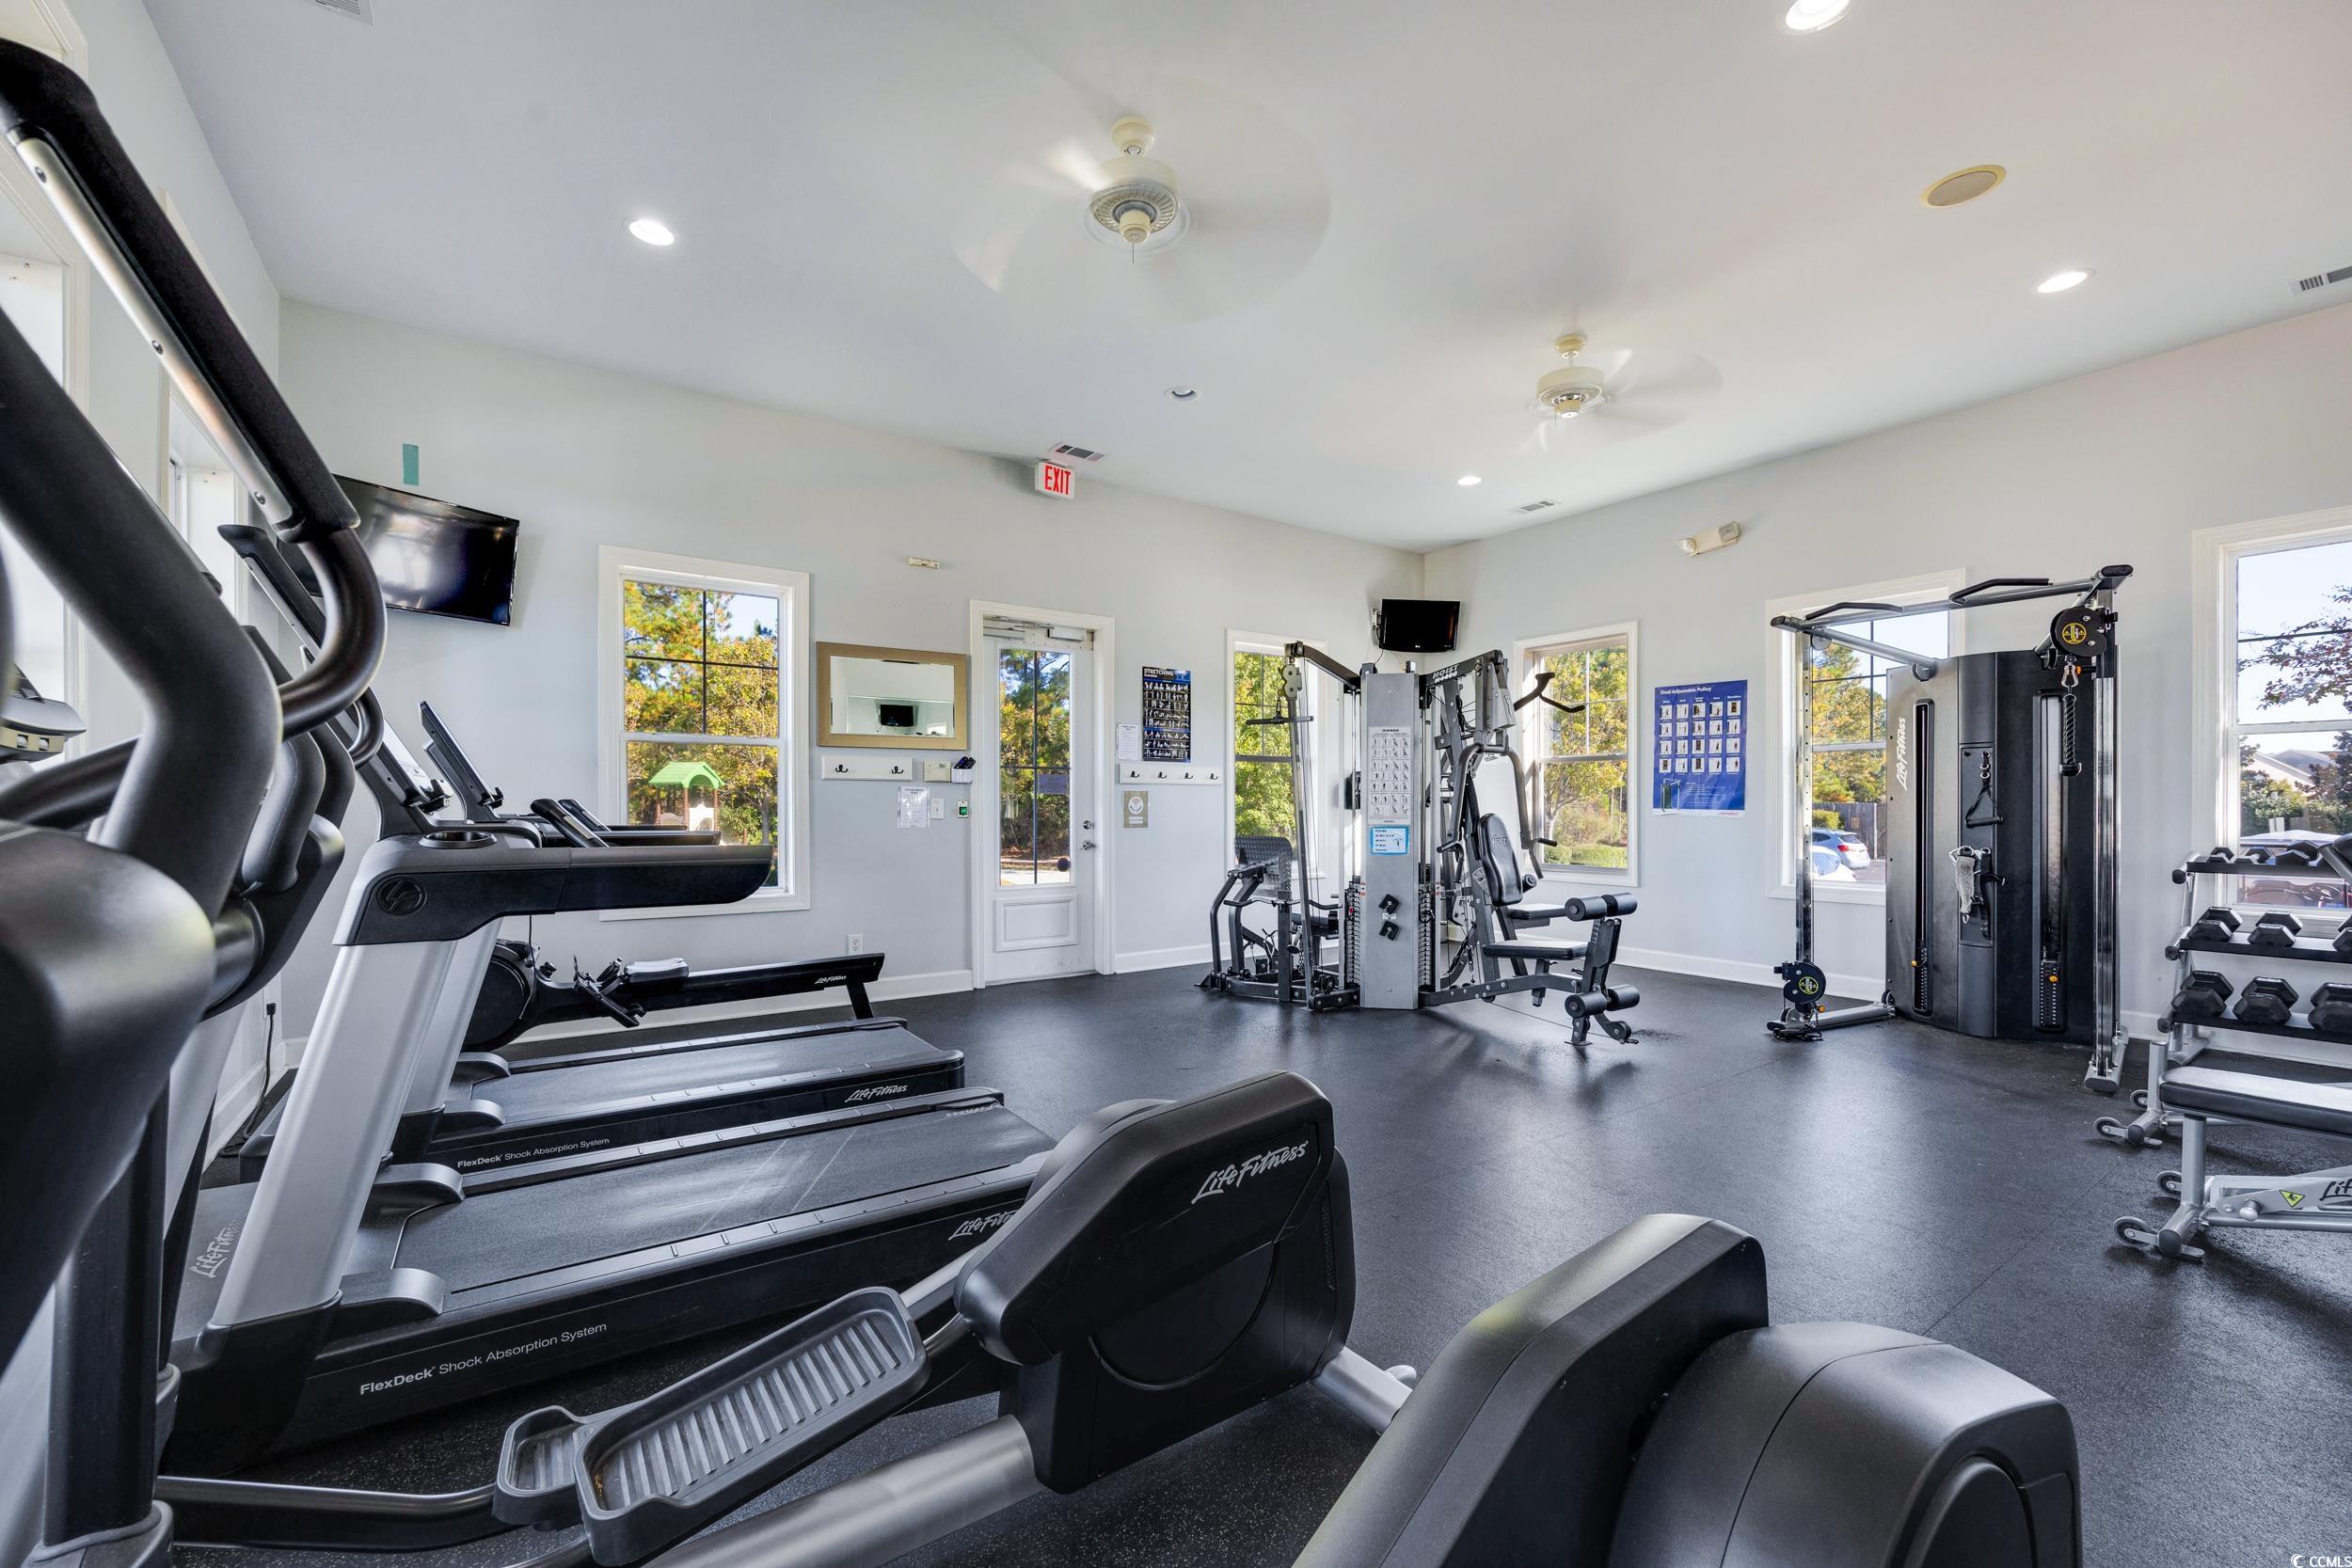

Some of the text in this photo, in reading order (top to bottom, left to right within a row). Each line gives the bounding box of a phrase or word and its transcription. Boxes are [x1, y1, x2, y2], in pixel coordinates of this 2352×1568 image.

[1044, 465, 1071, 495] EXIT
[1433, 664, 1459, 679] HOIST
[504, 1150, 532, 1161] Shock
[532, 1143, 579, 1156] Absorption
[580, 1138, 610, 1148] System
[438, 1355, 483, 1375] Shock
[485, 1335, 558, 1363] Absorption
[561, 1323, 608, 1343] System
